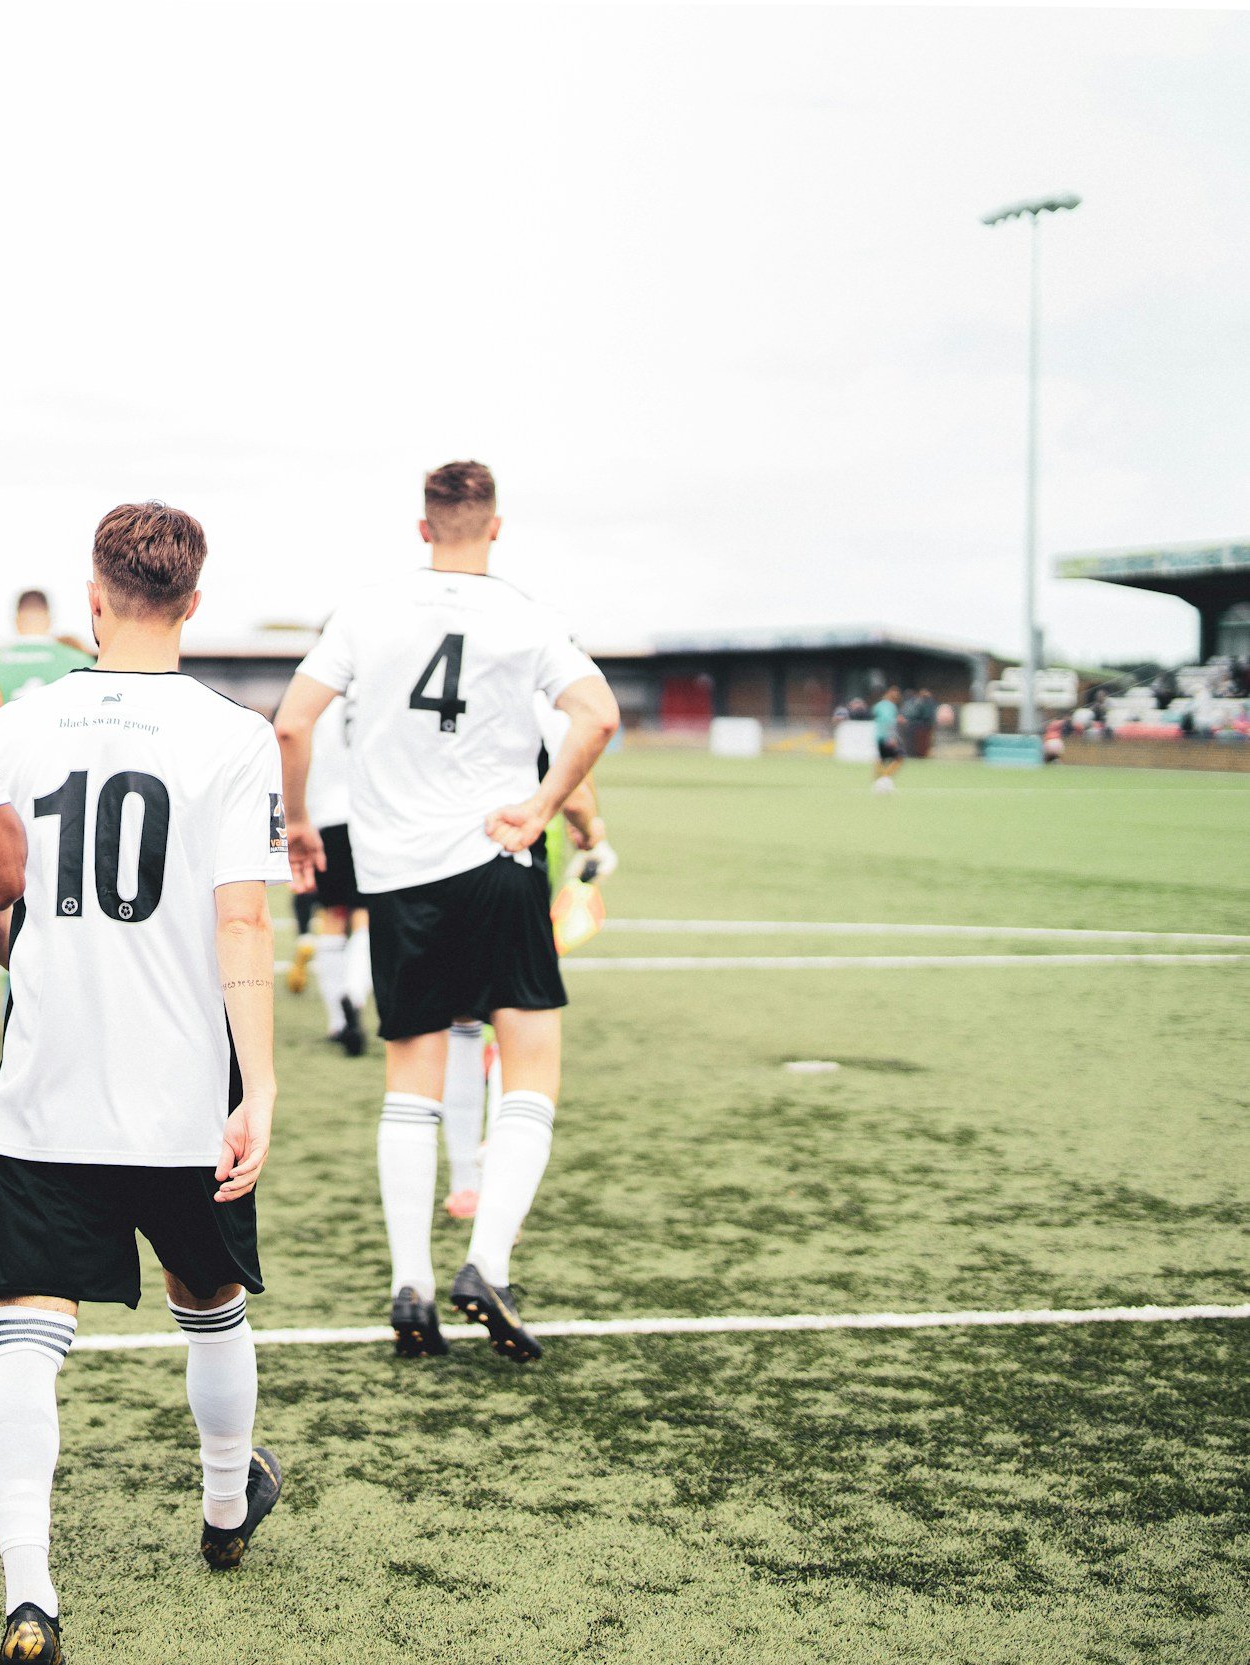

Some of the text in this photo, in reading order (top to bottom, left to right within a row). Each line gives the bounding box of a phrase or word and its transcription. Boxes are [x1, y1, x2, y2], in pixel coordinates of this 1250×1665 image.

[59, 716, 160, 736] black swan group
[409, 633, 467, 733] 4
[33, 770, 170, 923] 10
